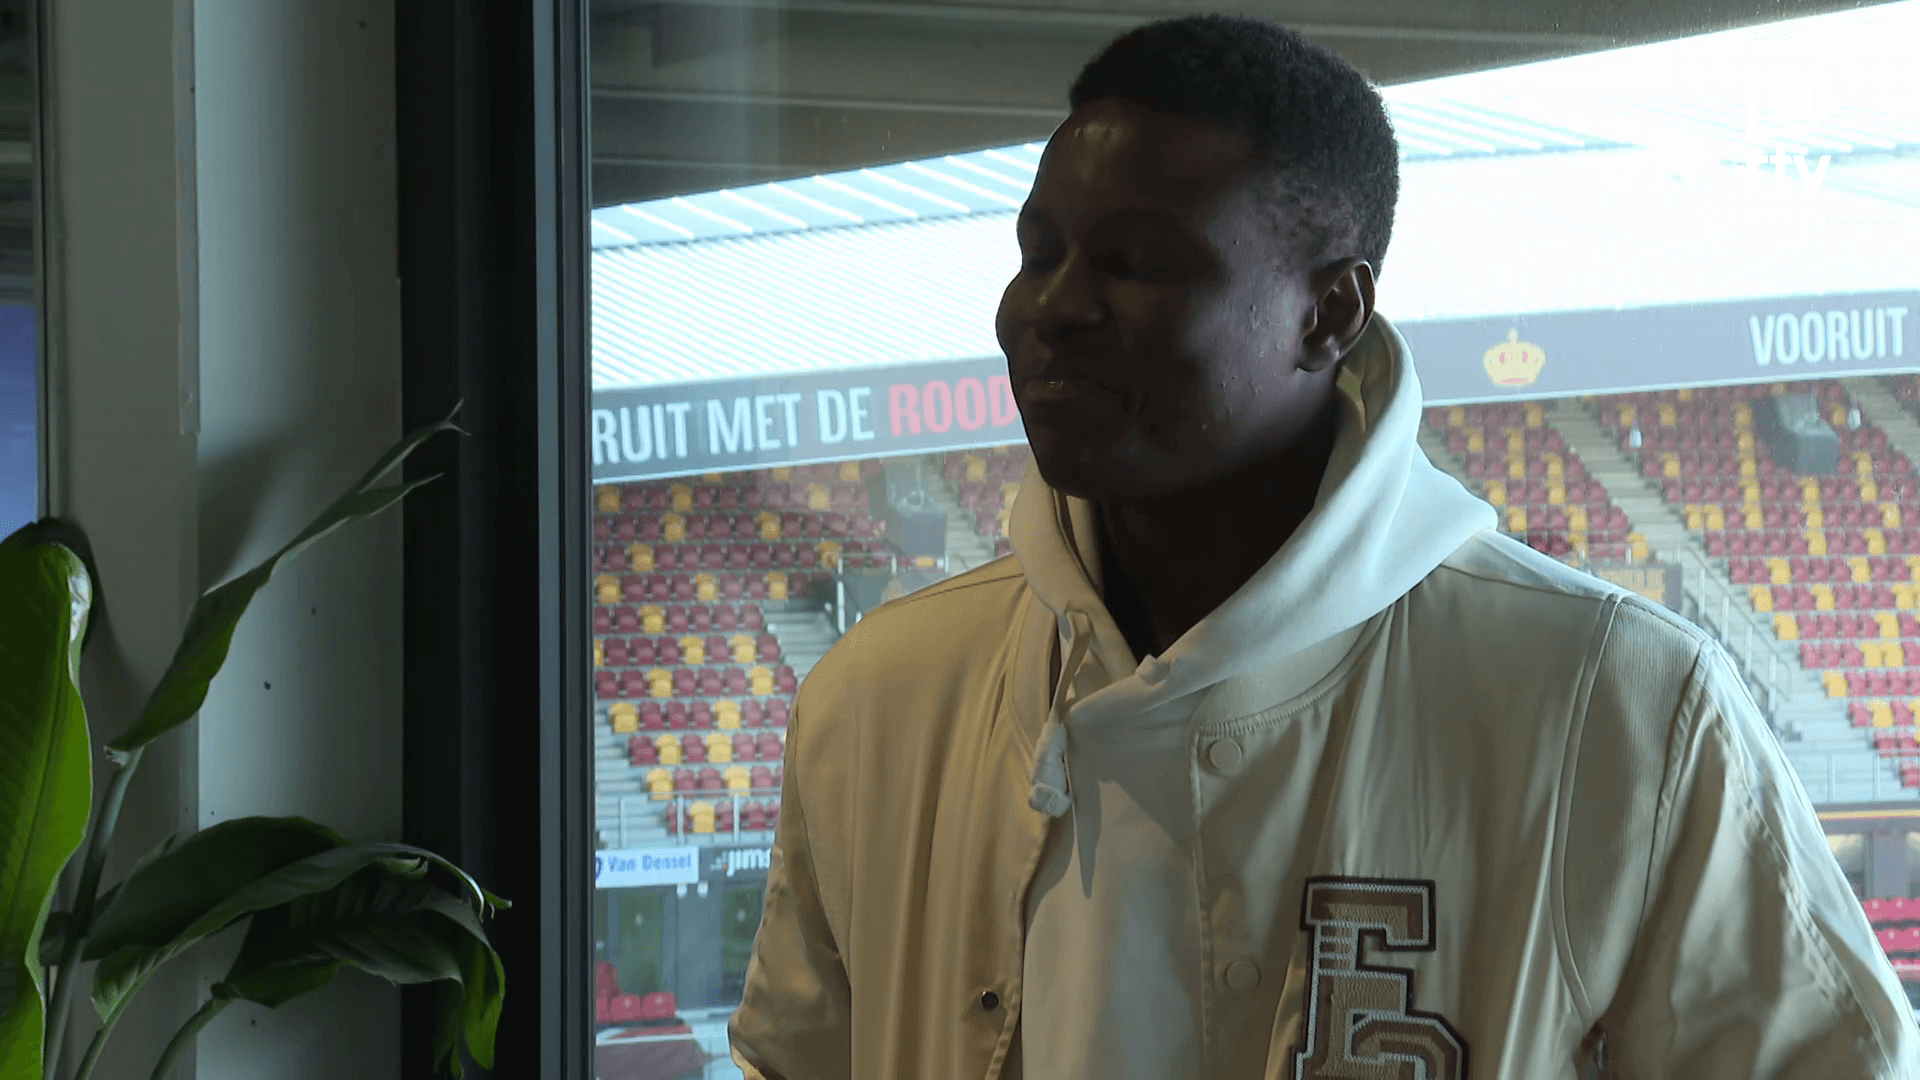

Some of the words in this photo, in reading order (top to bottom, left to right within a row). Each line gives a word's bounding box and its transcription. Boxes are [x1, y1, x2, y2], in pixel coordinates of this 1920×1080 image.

[1749, 306, 1909, 367] VOORUIT
[592, 402, 693, 465] RUIT
[706, 393, 802, 456] MET
[817, 386, 875, 445] DE
[888, 375, 1018, 437] ROOD
[608, 855, 637, 872] Van
